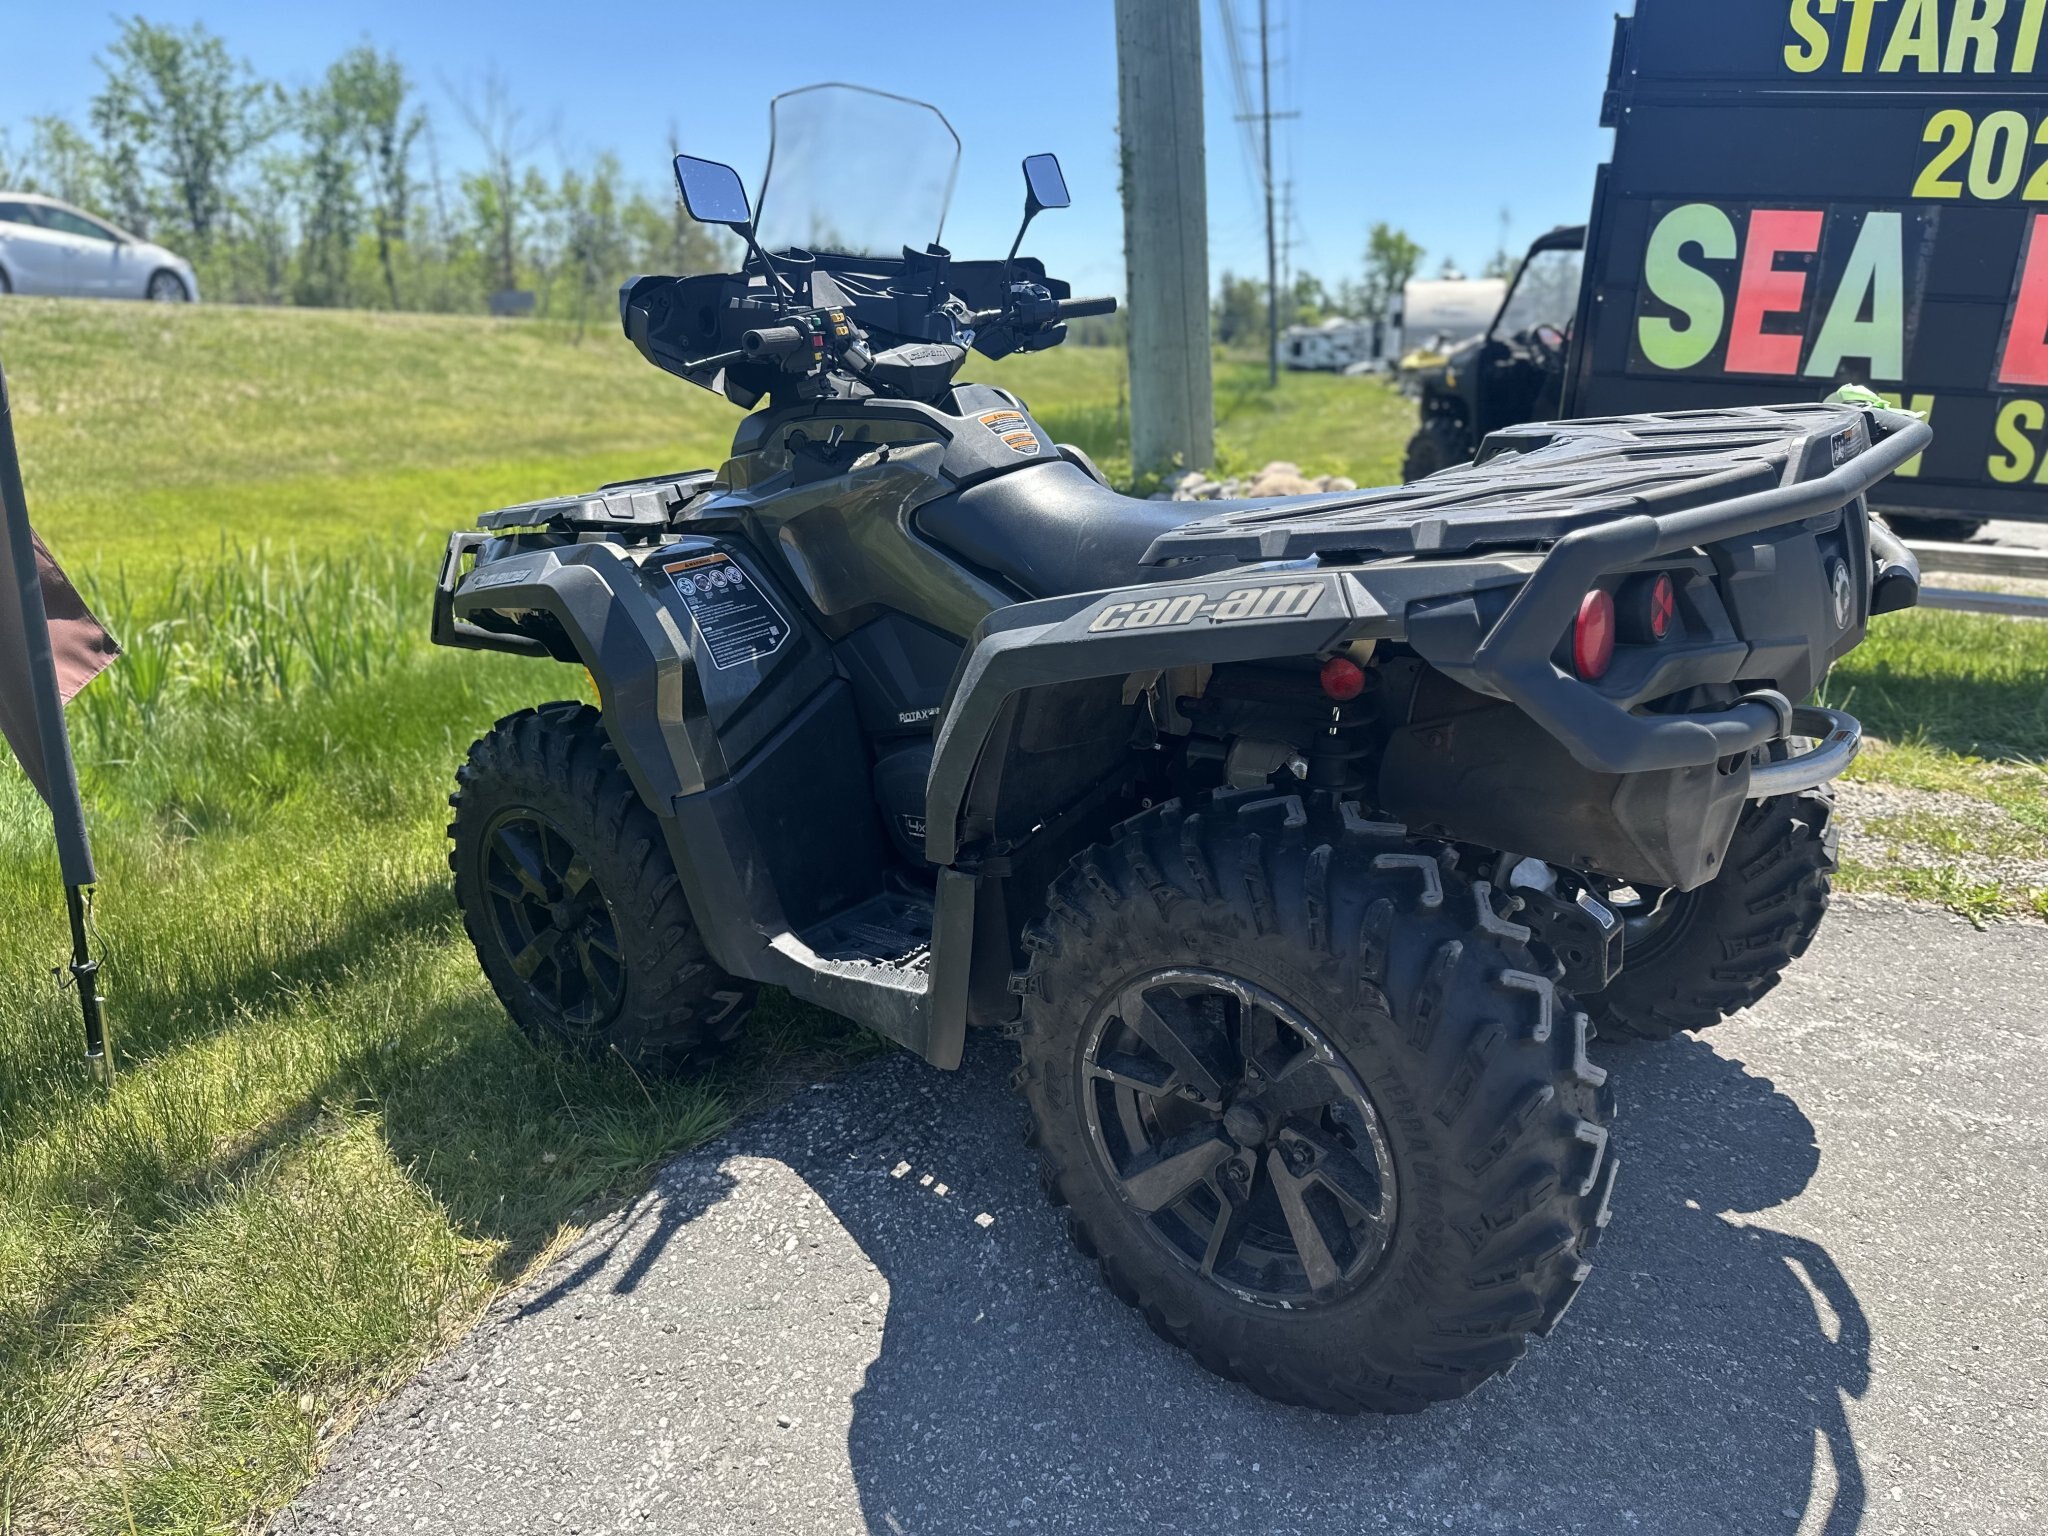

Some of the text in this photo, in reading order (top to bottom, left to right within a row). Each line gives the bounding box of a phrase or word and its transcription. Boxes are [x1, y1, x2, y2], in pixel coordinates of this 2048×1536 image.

[1638, 204, 1903, 381] SEA
[1988, 400, 2048, 484] S
[1089, 582, 1325, 632] can-am
[899, 710, 929, 722] ROTAX
[908, 819, 926, 833] 4x
